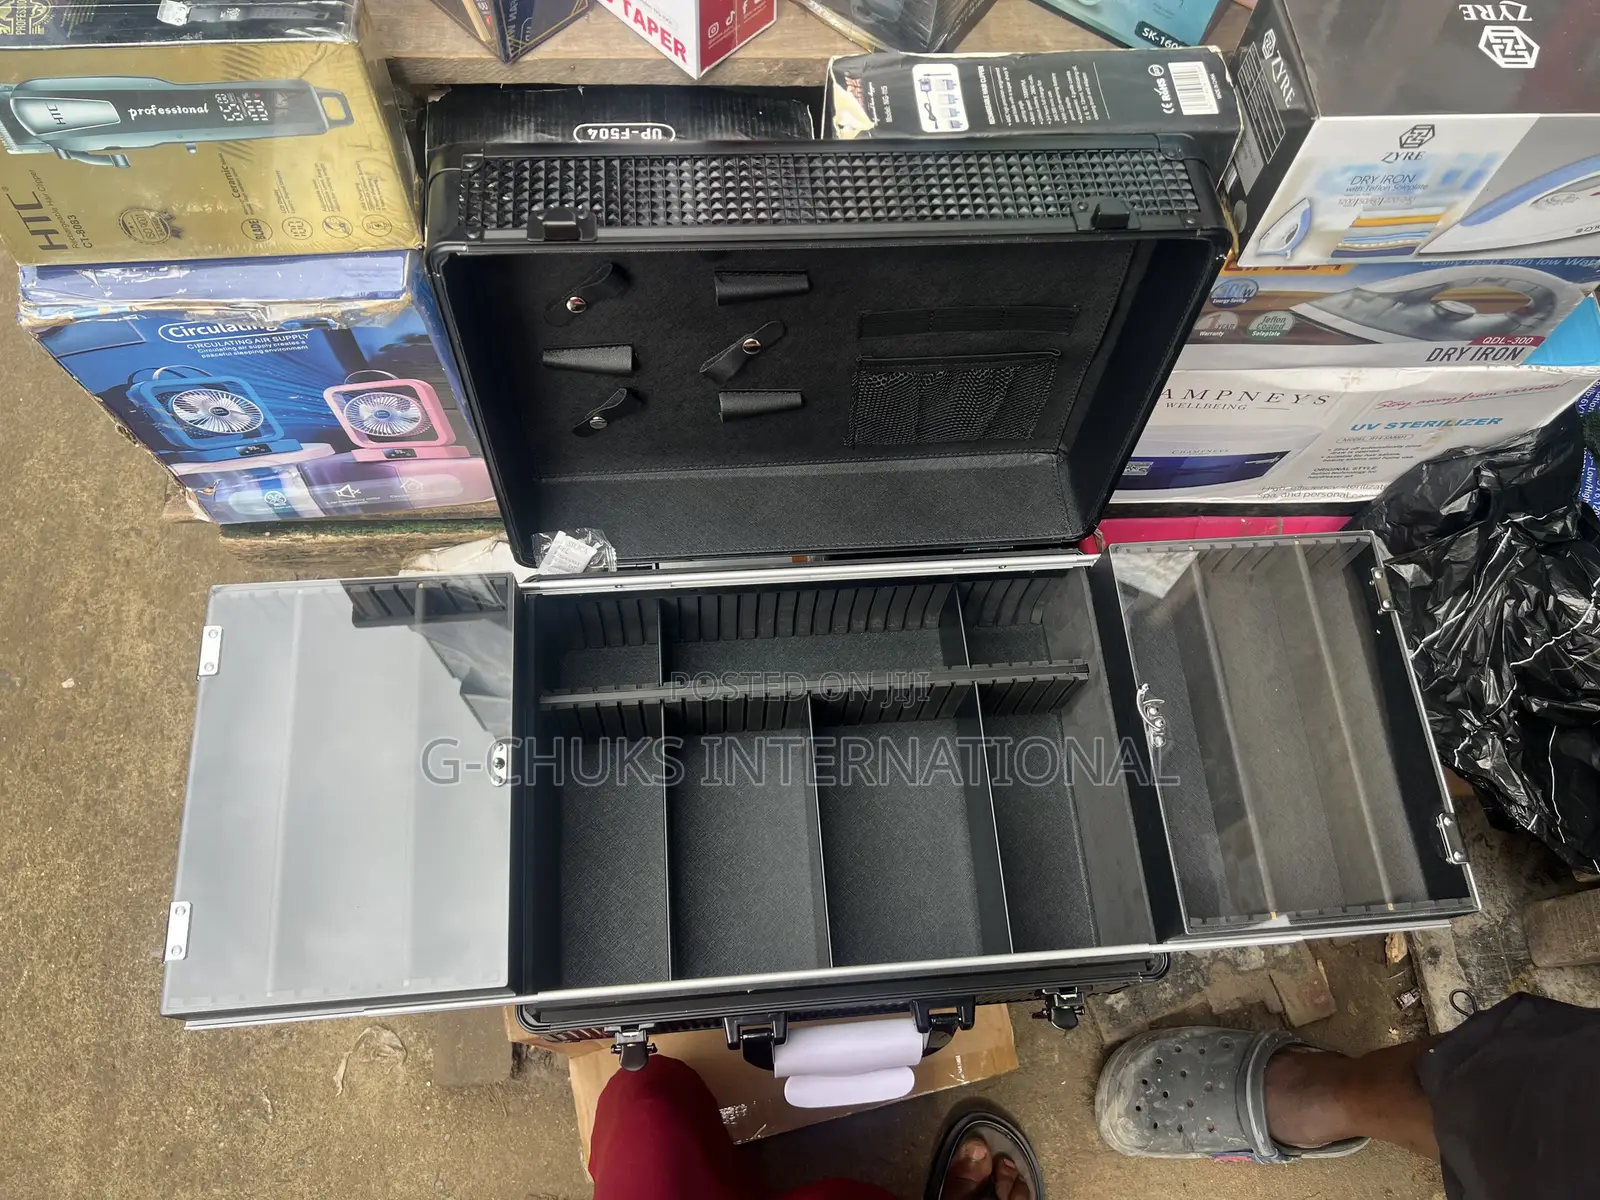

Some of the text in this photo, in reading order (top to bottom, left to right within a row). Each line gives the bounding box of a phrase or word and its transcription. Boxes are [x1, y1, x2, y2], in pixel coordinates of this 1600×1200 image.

[1458, 0, 1533, 21] ZYRE
[621, 1, 688, 64] TAPER
[1271, 49, 1295, 108] ZYRE
[127, 103, 209, 120] professional
[587, 127, 663, 140] UP-F504
[1381, 151, 1426, 163] ZYRE
[221, 165, 242, 199] Ceramic
[1350, 174, 1416, 186] DRY IRON
[29, 169, 80, 249] Rechargeable Hair Clipper
[6, 191, 68, 251] HTC
[67, 214, 93, 249] CT-8083
[248, 220, 266, 240] BLADE
[1536, 258, 1560, 266] low
[1256, 322, 1287, 330] Coated
[1261, 315, 1287, 324] Teflon
[1199, 330, 1225, 338] Warranty
[1251, 330, 1281, 338] Soleplate
[1482, 336, 1534, 345] QDL-300
[187, 333, 309, 350] CIRCULATING AIR SUPPLY
[197, 345, 237, 354] Circulating
[273, 340, 298, 348] creates
[233, 349, 264, 357] sleeping
[264, 345, 309, 353] environment
[1425, 346, 1525, 362] DRY IRON
[1166, 402, 1248, 411] WELLBEING
[1376, 400, 1412, 410] Stay
[1350, 417, 1504, 431] UV STERILIZER
